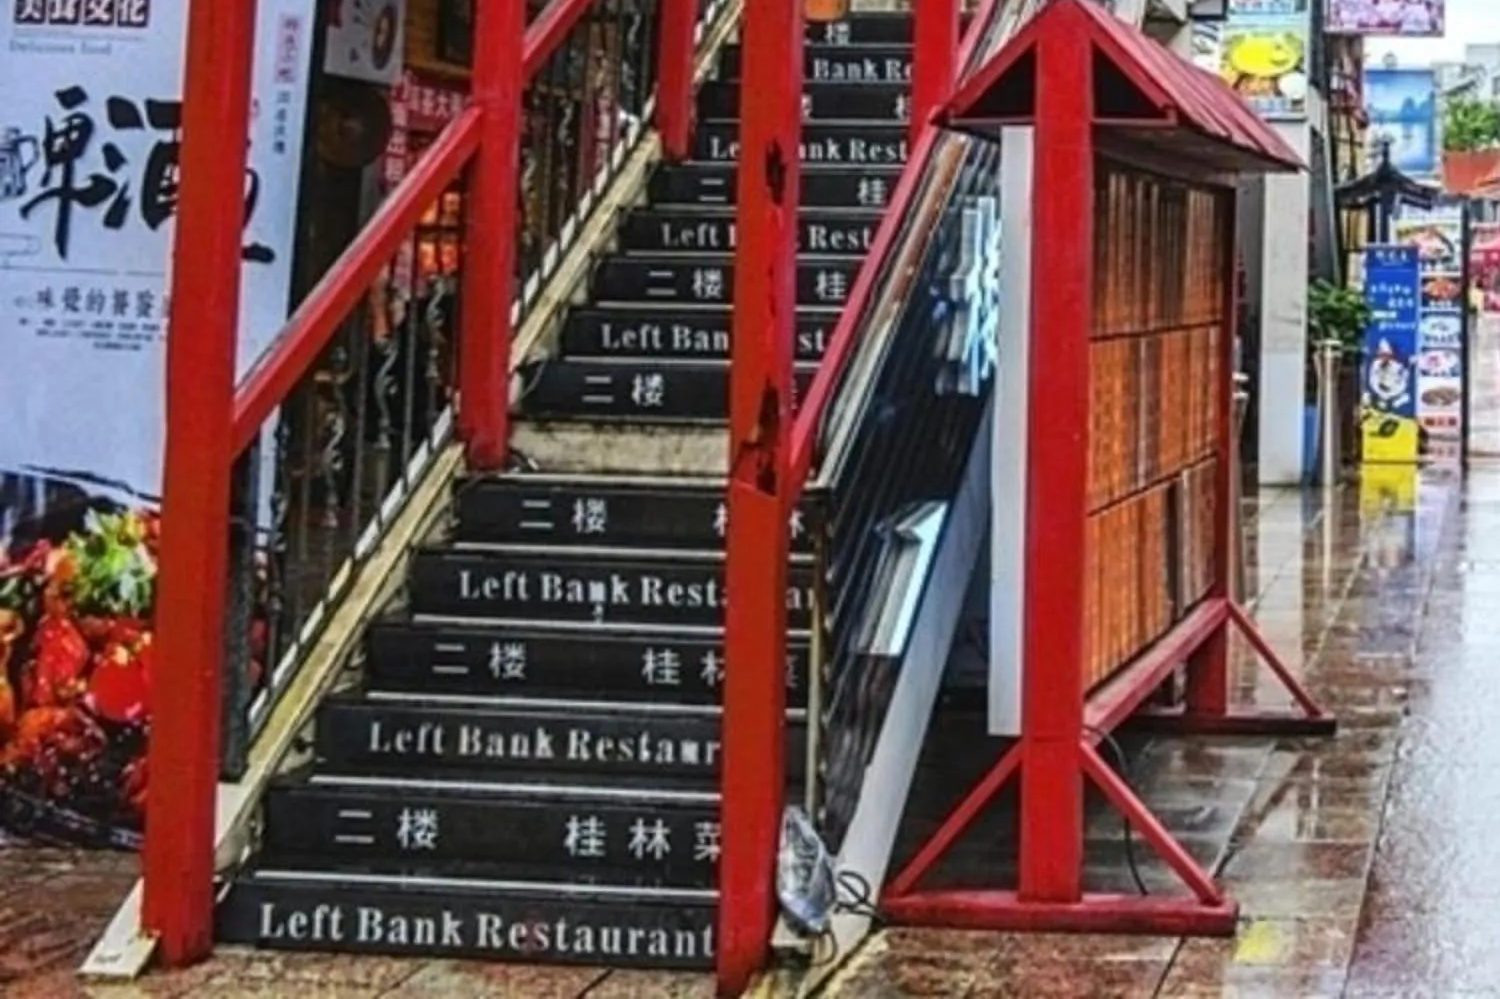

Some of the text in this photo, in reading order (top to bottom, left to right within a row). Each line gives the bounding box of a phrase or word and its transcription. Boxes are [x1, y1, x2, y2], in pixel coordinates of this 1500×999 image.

[812, 58, 879, 83] Bank
[710, 136, 739, 159] Le
[662, 224, 719, 249] Left
[647, 270, 722, 297] 二楼
[601, 325, 729, 352] Left Ban
[582, 373, 664, 406] 二楼
[519, 492, 605, 536] 二楼
[459, 569, 528, 601] Left
[541, 573, 630, 606] Bank
[433, 642, 526, 680] 二楼
[369, 722, 720, 764] Left Bank Restaur
[335, 808, 438, 851] 二楼
[260, 903, 714, 958] Left Bank Restaurant
